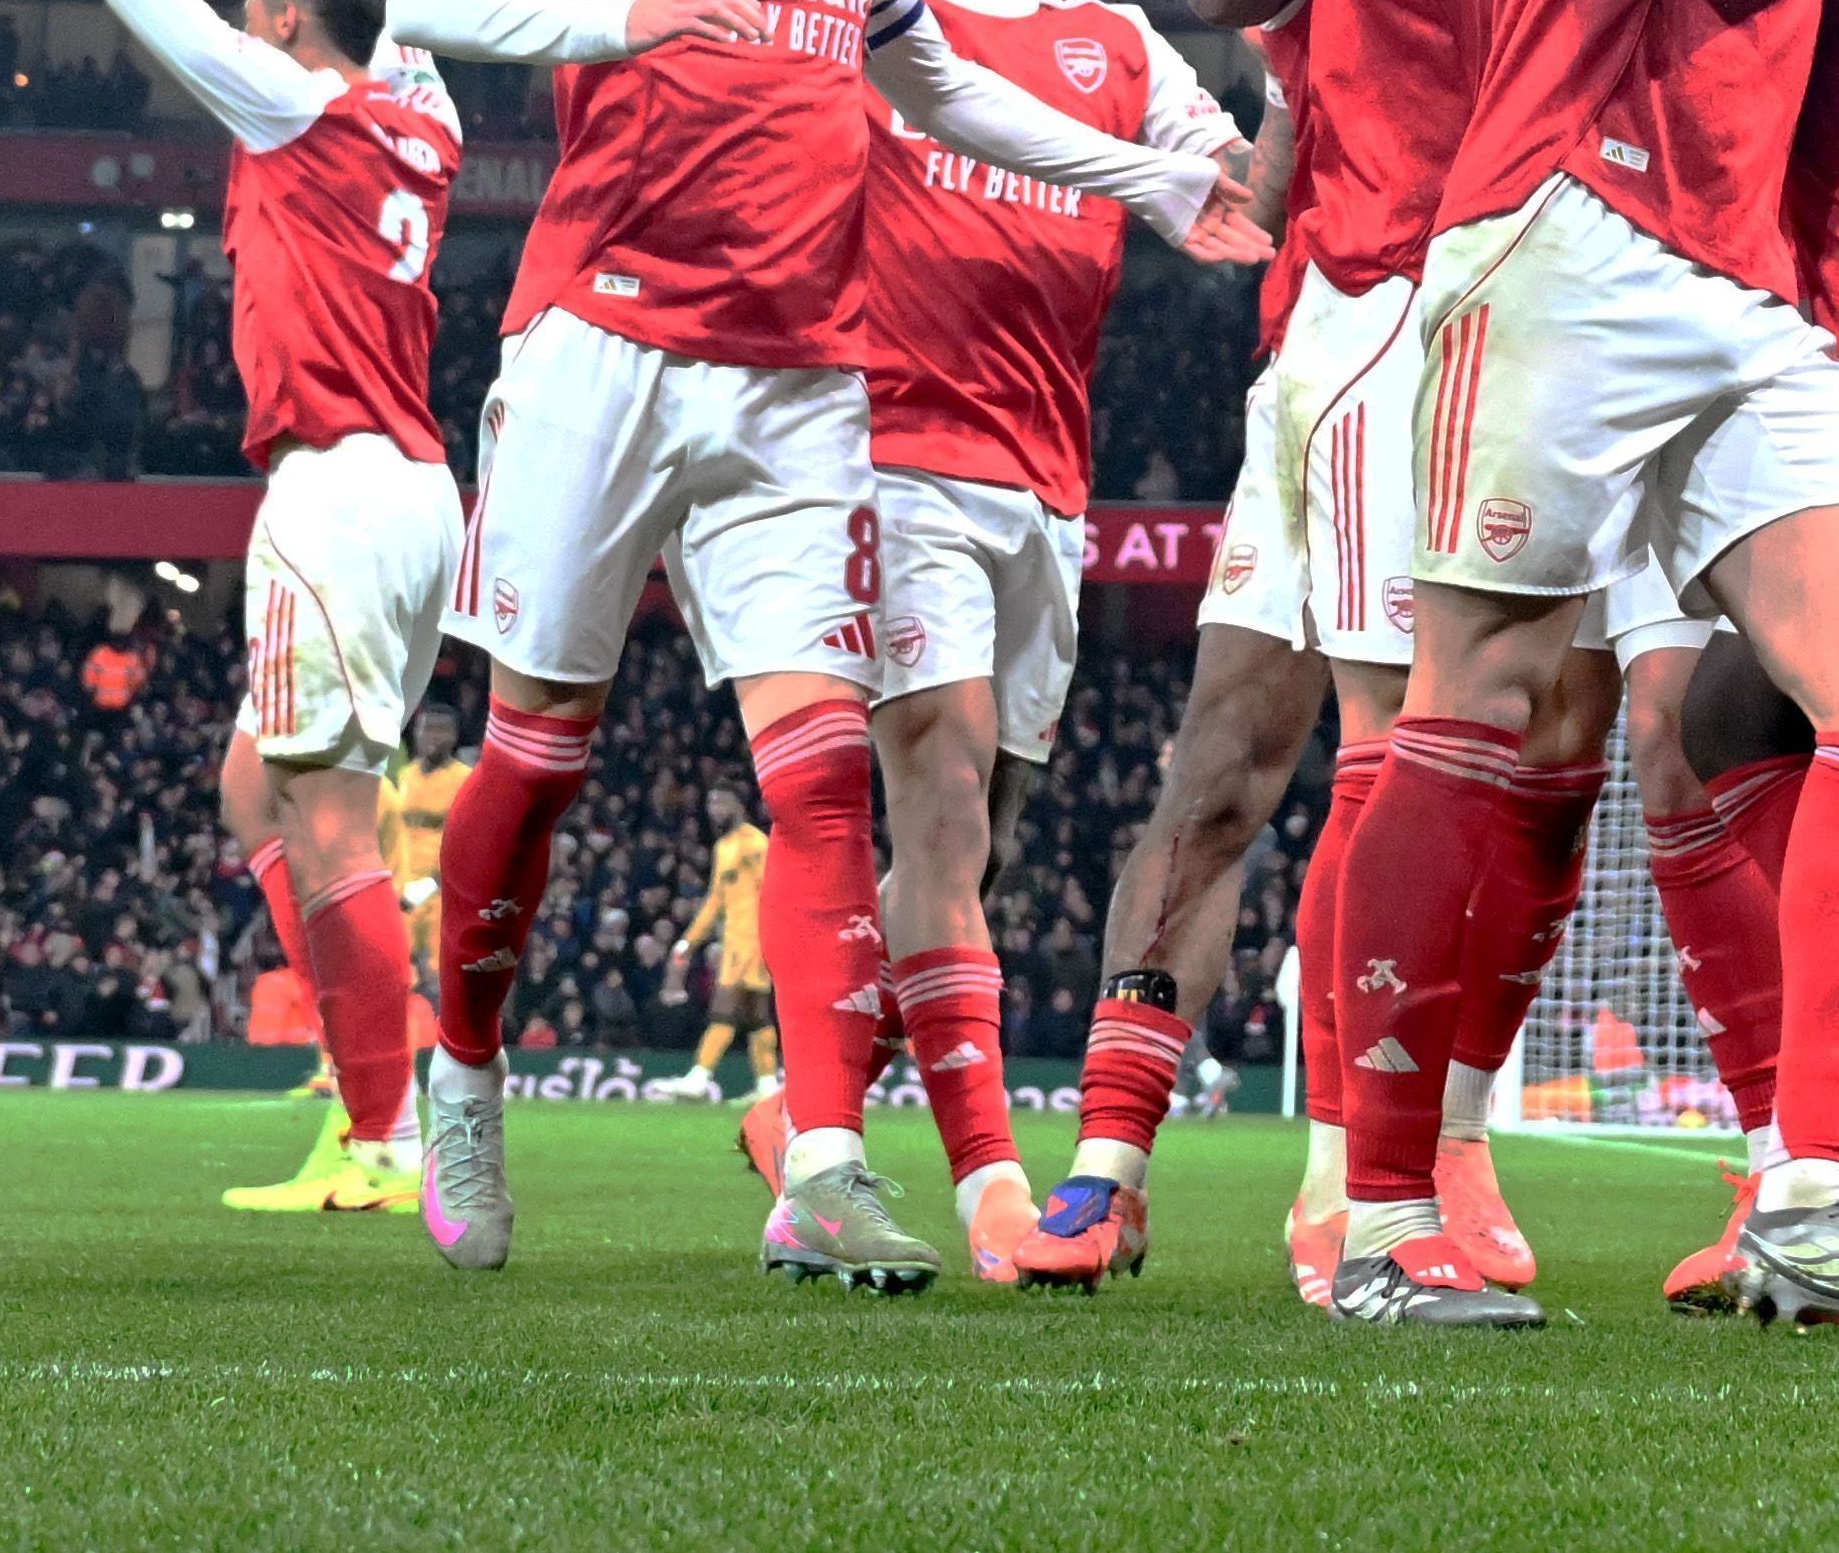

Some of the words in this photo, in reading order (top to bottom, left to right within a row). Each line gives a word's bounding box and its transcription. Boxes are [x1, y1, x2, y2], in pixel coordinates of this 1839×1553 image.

[924, 150, 977, 192] FLY
[844, 503, 882, 605] 8
[1113, 522, 1190, 570] AT
